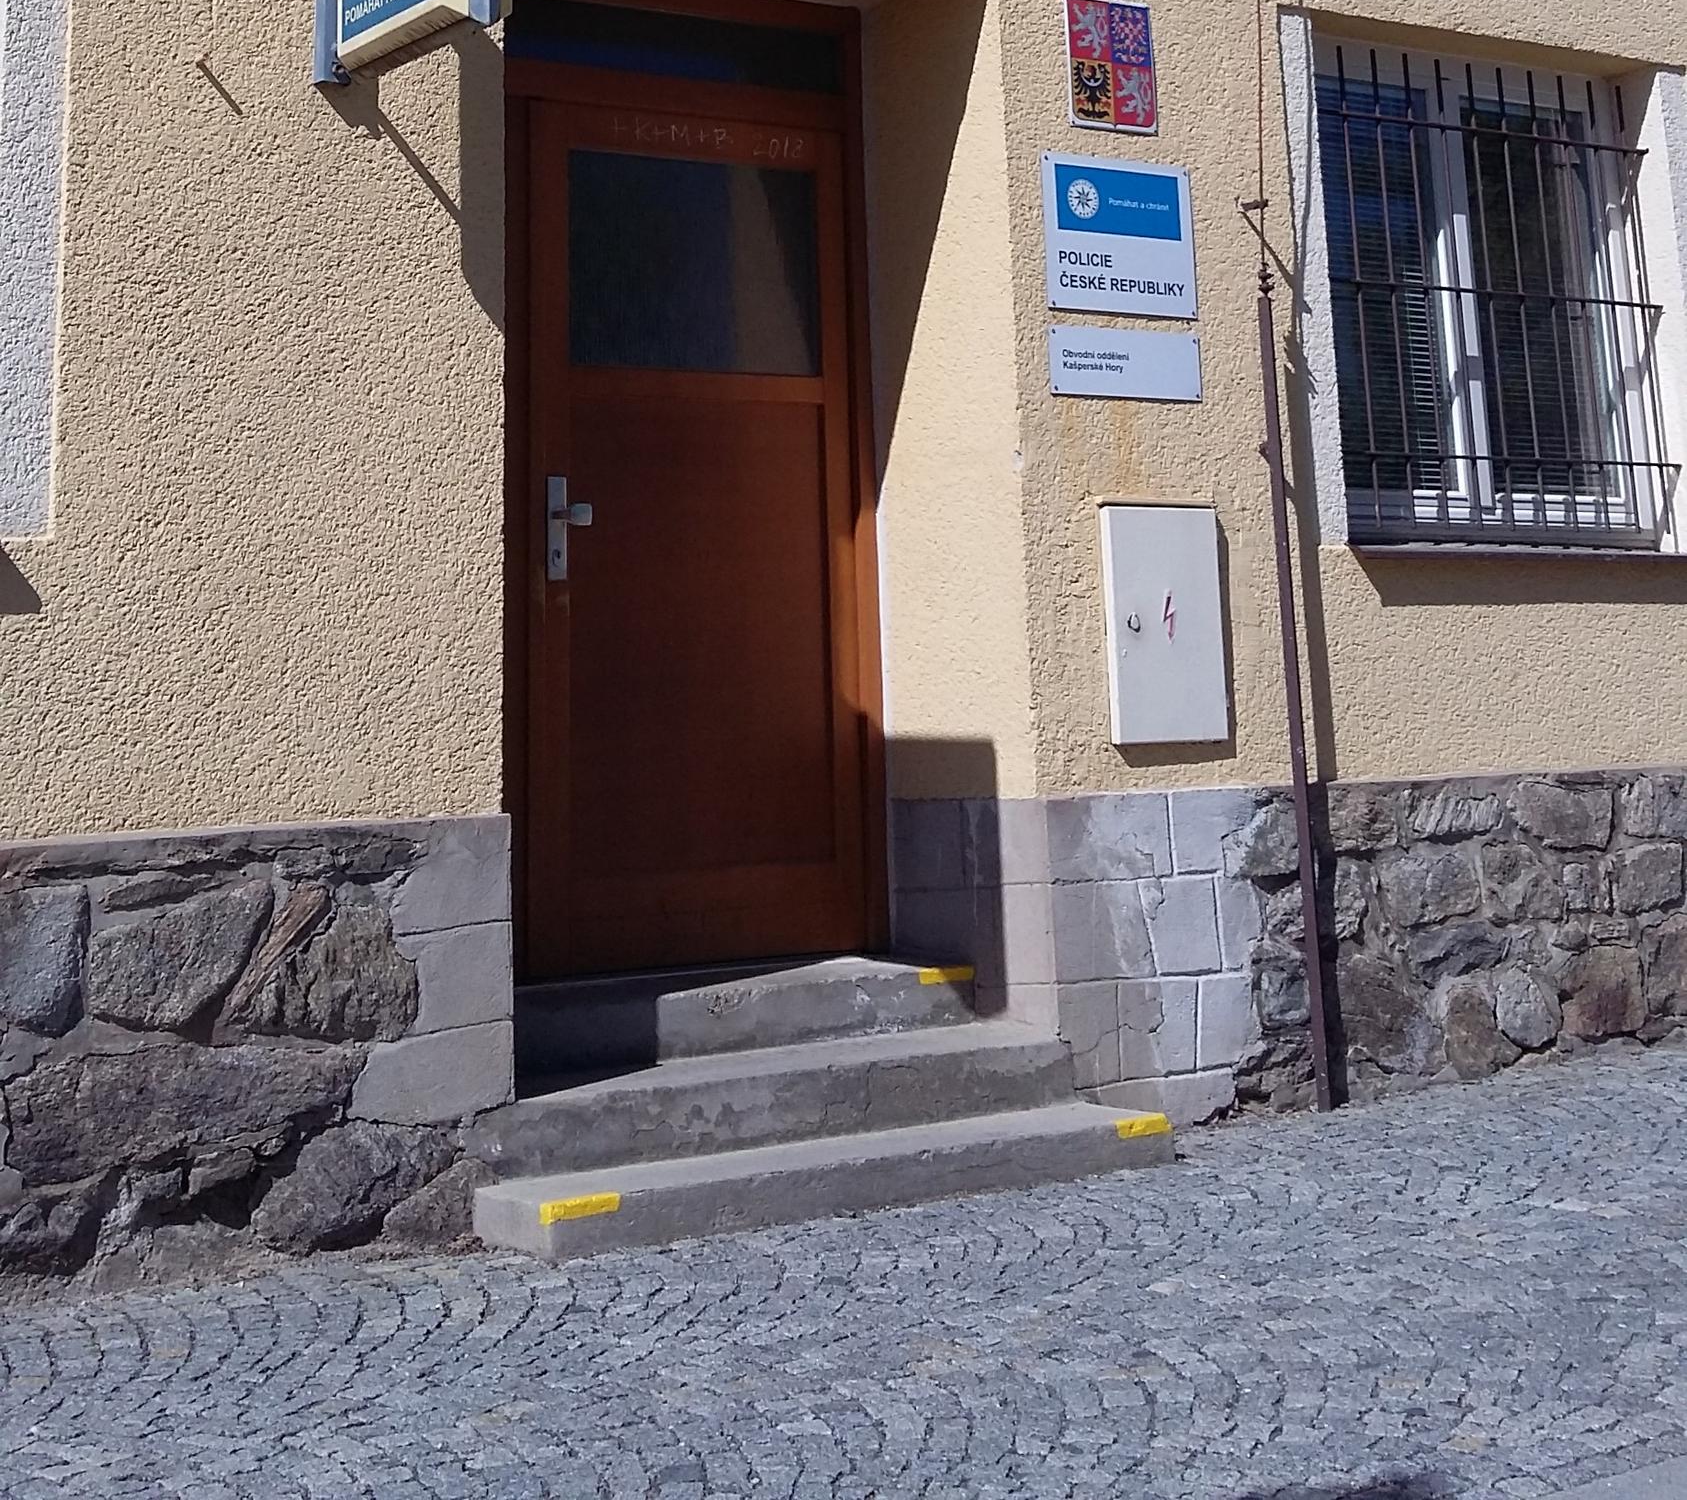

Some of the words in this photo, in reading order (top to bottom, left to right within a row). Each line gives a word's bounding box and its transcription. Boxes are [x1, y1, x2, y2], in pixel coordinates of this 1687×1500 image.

[1108, 197, 1139, 209] Pomáhat
[1146, 202, 1170, 211] chránit
[1058, 250, 1113, 268] POLICIE
[1059, 271, 1107, 291] ČESKÉ
[1110, 278, 1185, 297] REPUBLIKY
[1062, 349, 1095, 359] Obvodní
[1096, 351, 1130, 361] oddělení
[1062, 360, 1104, 371] Kašperské
[1105, 362, 1124, 374] Hory
